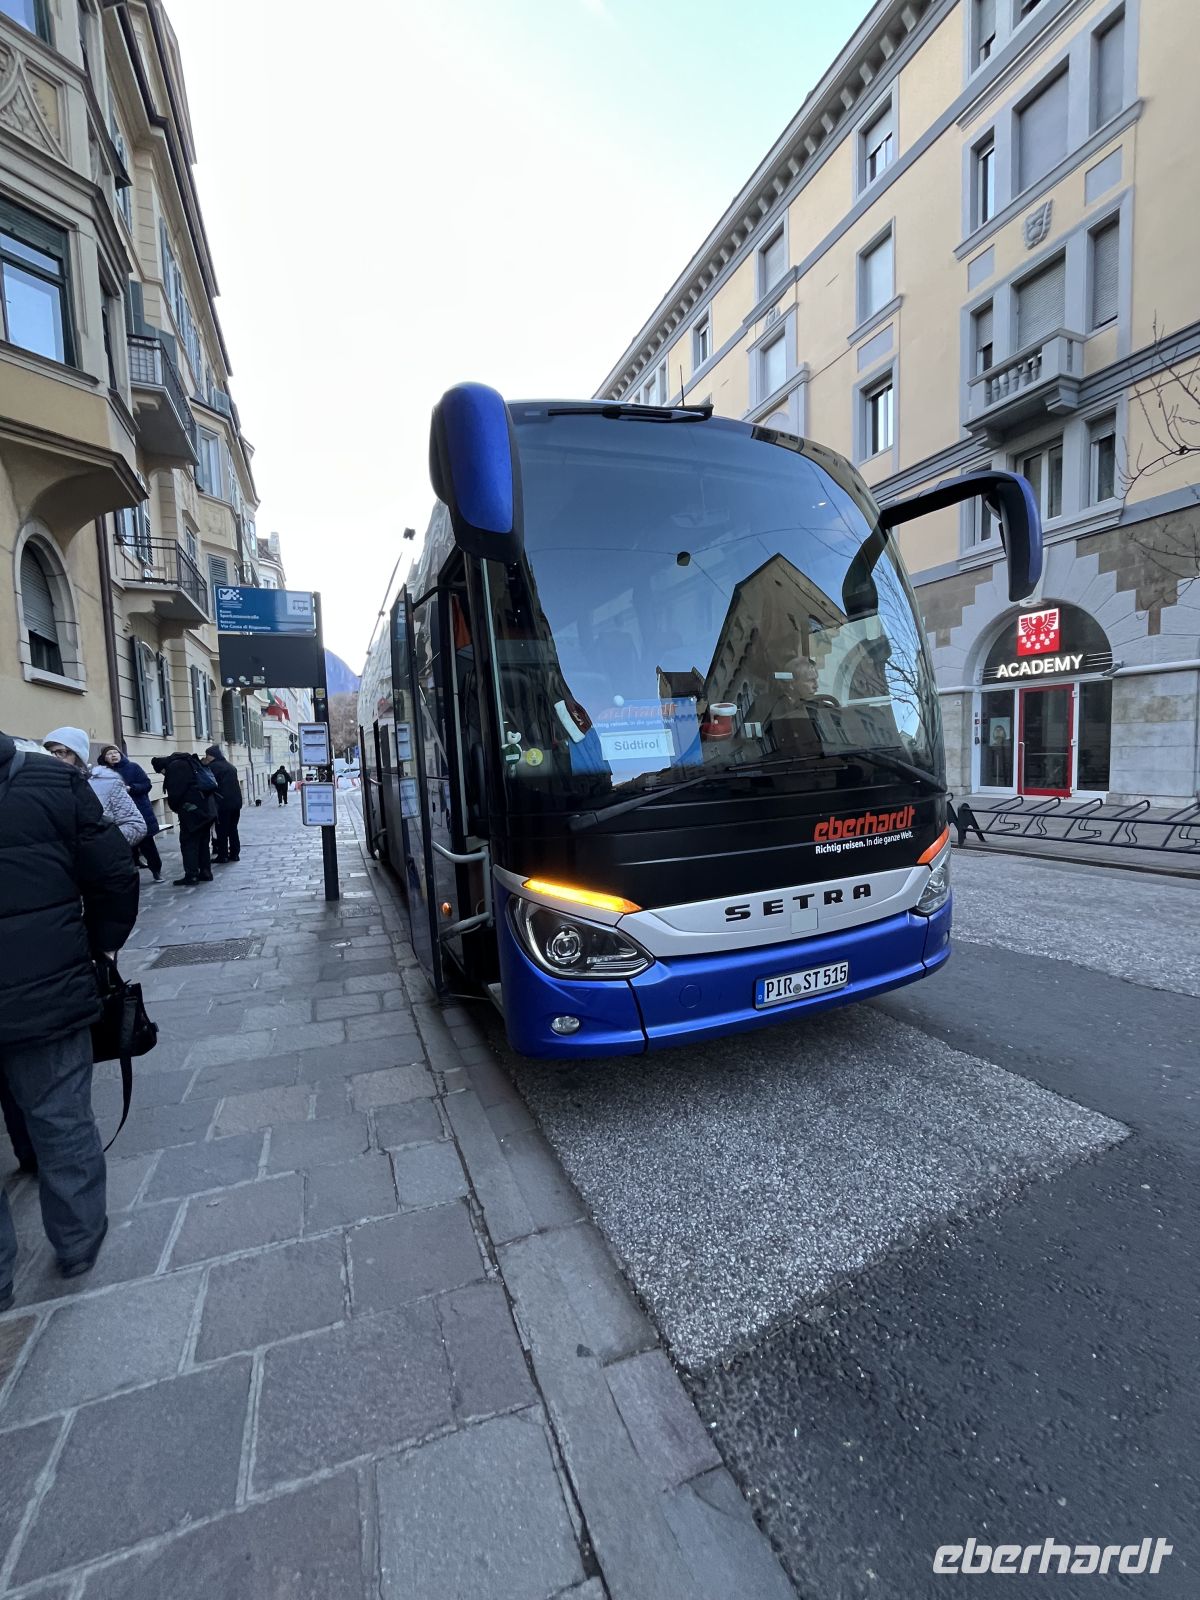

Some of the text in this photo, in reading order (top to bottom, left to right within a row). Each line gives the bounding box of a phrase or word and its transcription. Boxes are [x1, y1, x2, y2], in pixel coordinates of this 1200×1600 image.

[996, 654, 1083, 678] ACADEMY
[614, 738, 659, 751] Südtirol
[814, 805, 915, 843] eberhardt
[815, 830, 914, 855] Richtig reisen. In die ganze Welt.
[724, 883, 872, 922] SETRA
[766, 977, 792, 999] PIR
[823, 964, 847, 986] 515
